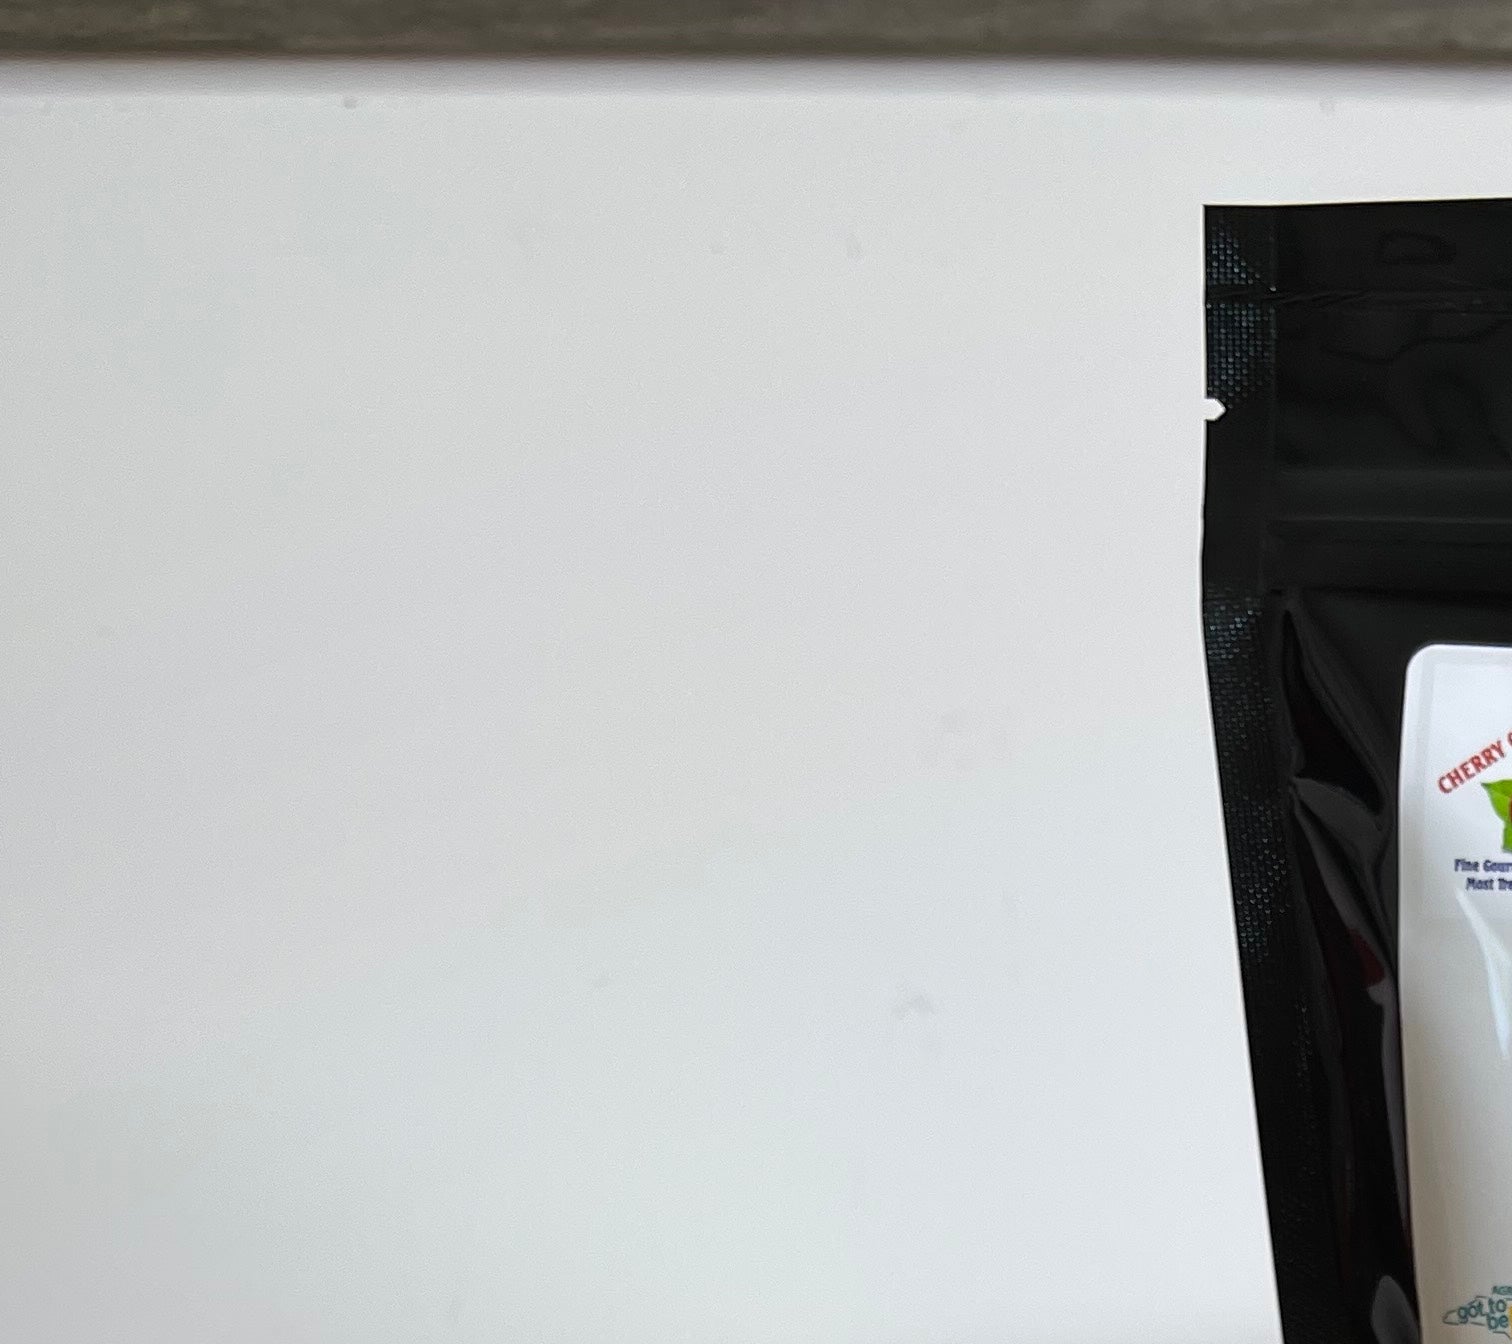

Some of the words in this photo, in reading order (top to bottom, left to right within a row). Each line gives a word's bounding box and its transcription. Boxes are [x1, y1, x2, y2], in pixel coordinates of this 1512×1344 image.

[1438, 740, 1506, 793] CHERRY
[1455, 859, 1479, 873] Fine
[1466, 878, 1494, 891] Most
[1458, 1301, 1487, 1324] got
[1488, 1298, 1507, 1315] to
[1487, 1314, 1508, 1330] be
